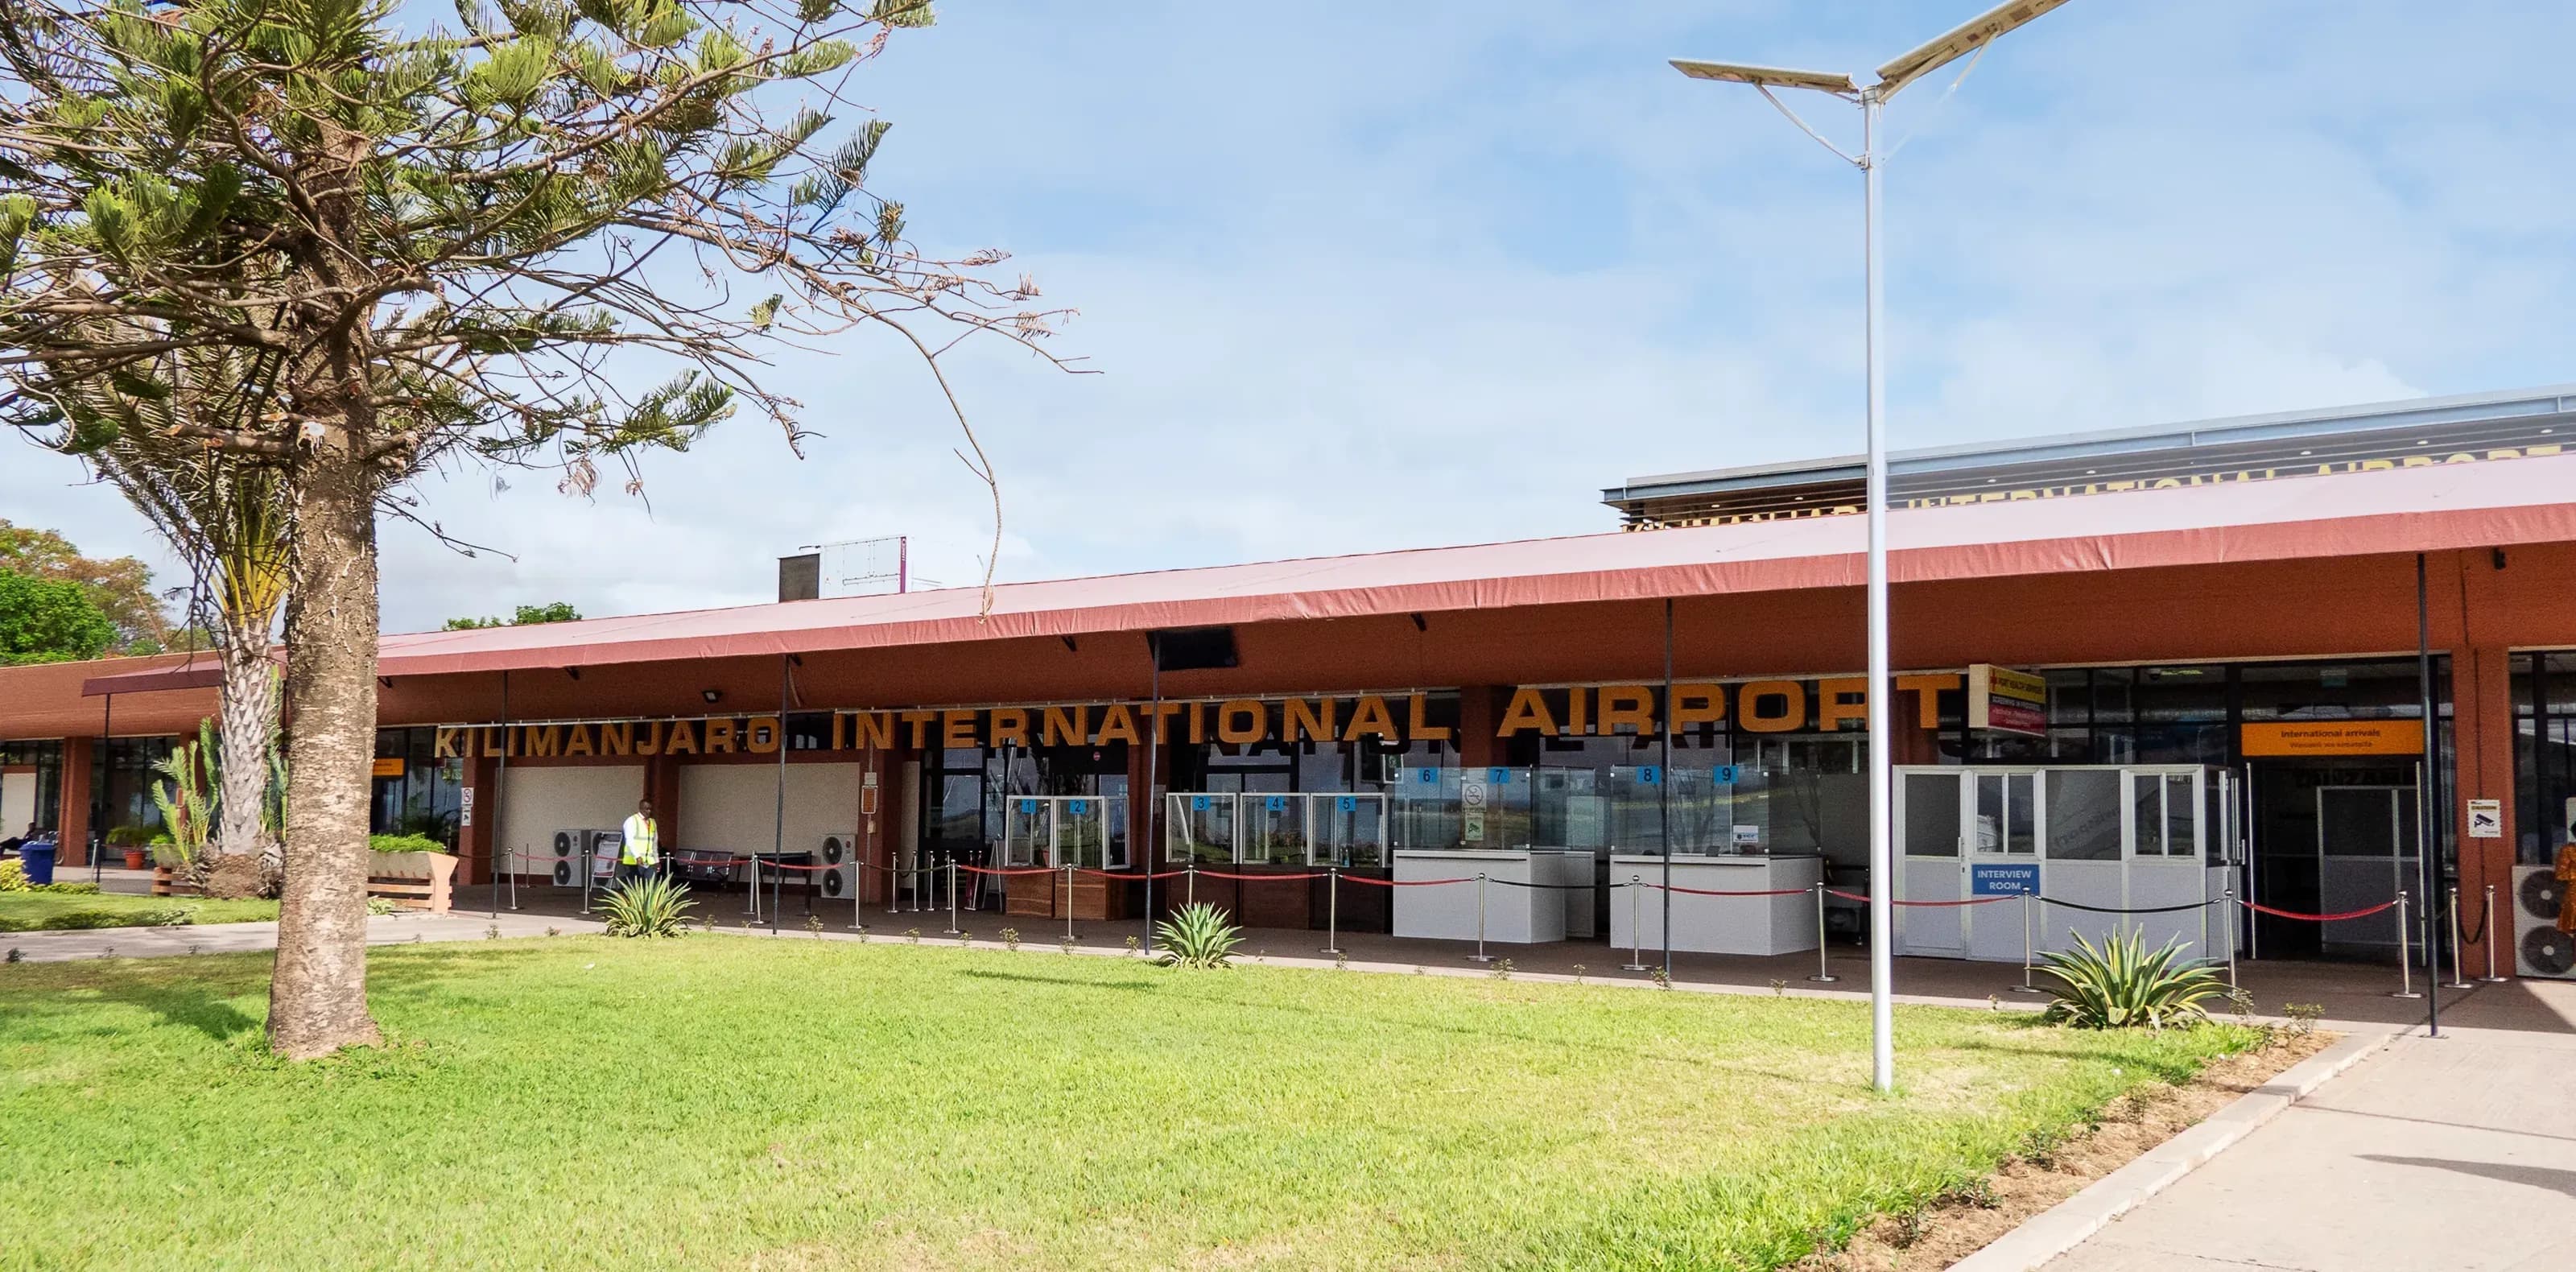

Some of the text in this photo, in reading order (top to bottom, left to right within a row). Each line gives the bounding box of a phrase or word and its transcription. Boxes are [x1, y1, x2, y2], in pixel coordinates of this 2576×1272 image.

[434, 674, 1960, 758] KILIMANJARO INTERNATIONAL AIRPORT
[2281, 728, 2380, 737] International arrivals
[1423, 770, 1430, 782] 6
[1496, 769, 1503, 781] 7
[1644, 768, 1652, 782] 8
[1723, 767, 1732, 781] 9
[1075, 800, 1080, 812] 2
[1198, 798, 1204, 808] 3
[1272, 798, 1279, 808] 4
[1343, 799, 1350, 810] 5
[1977, 870, 2032, 879] INTERVIEW
[1989, 882, 2021, 890] ROOM
